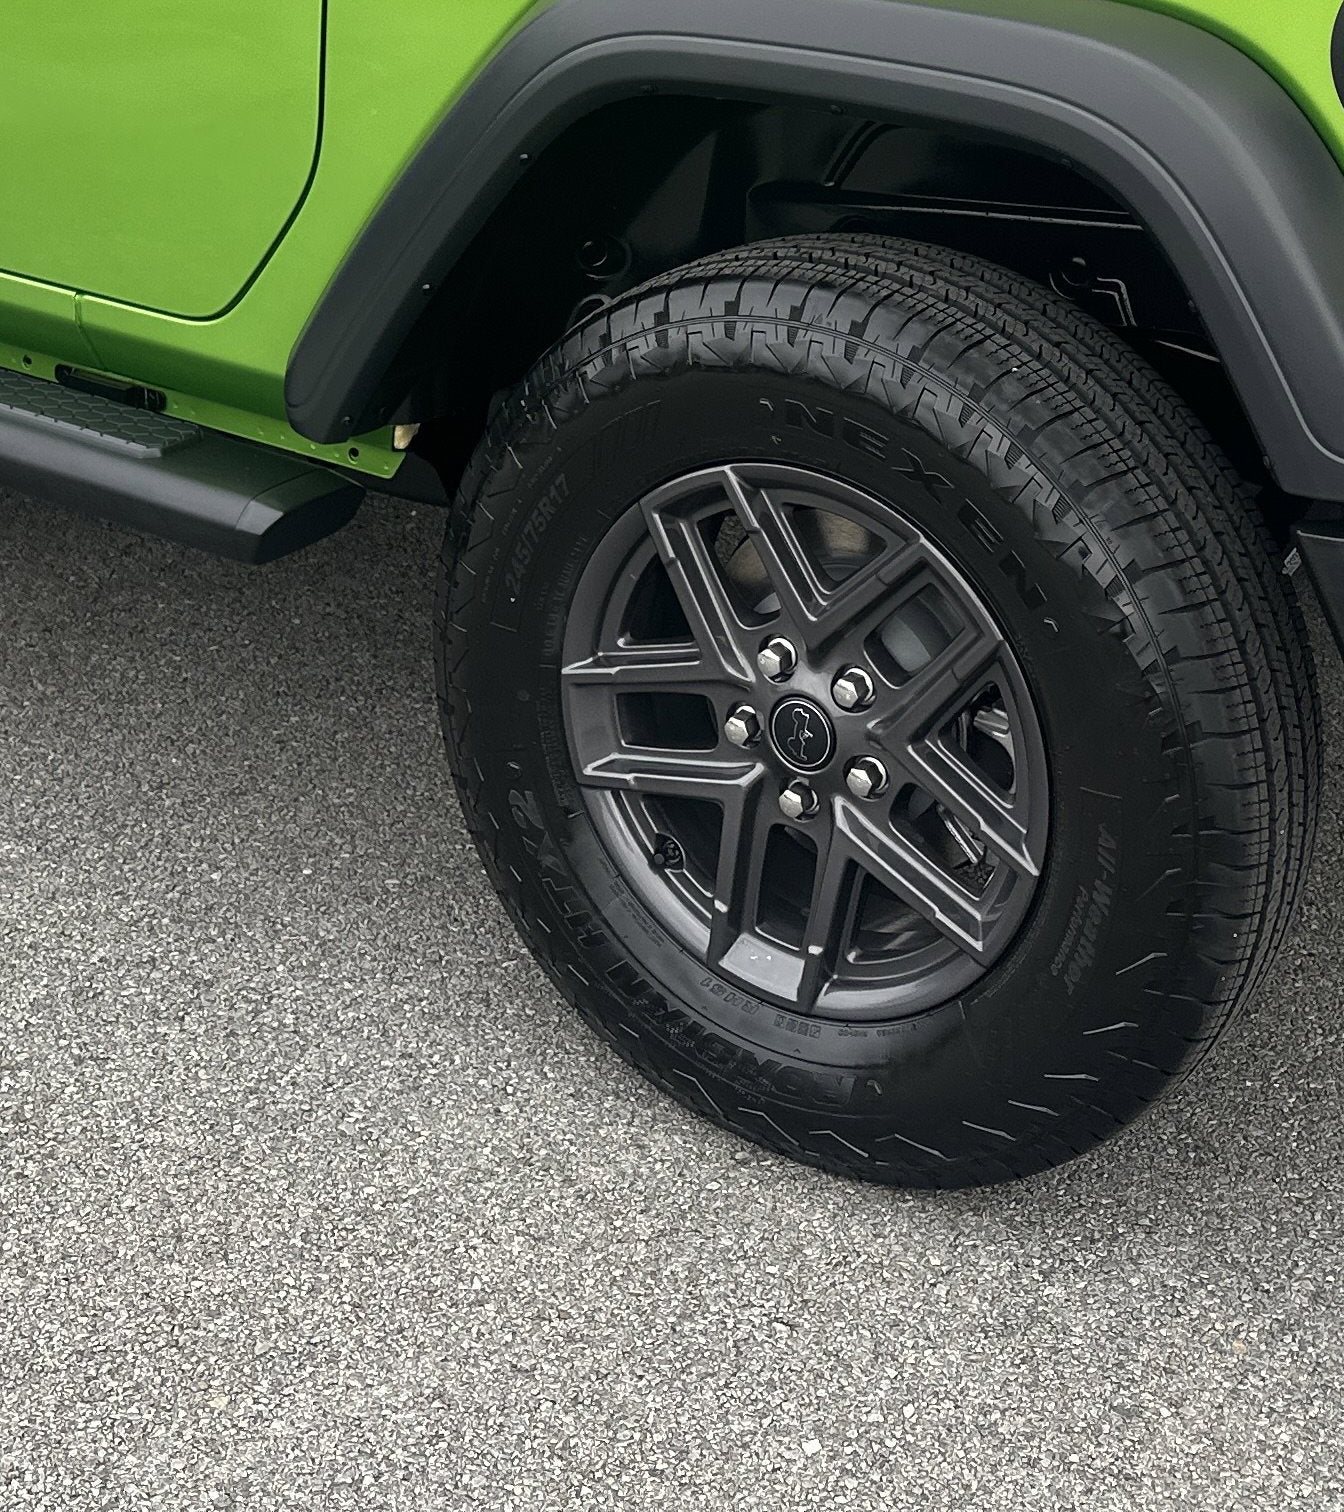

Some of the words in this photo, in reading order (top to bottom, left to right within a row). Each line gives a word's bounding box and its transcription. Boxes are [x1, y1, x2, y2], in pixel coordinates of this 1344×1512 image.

[504, 472, 570, 595] 245/75R17
[783, 398, 1050, 611] NEXEN
[1064, 823, 1117, 997] All-Weather
[605, 958, 858, 1108] ROADIAN
